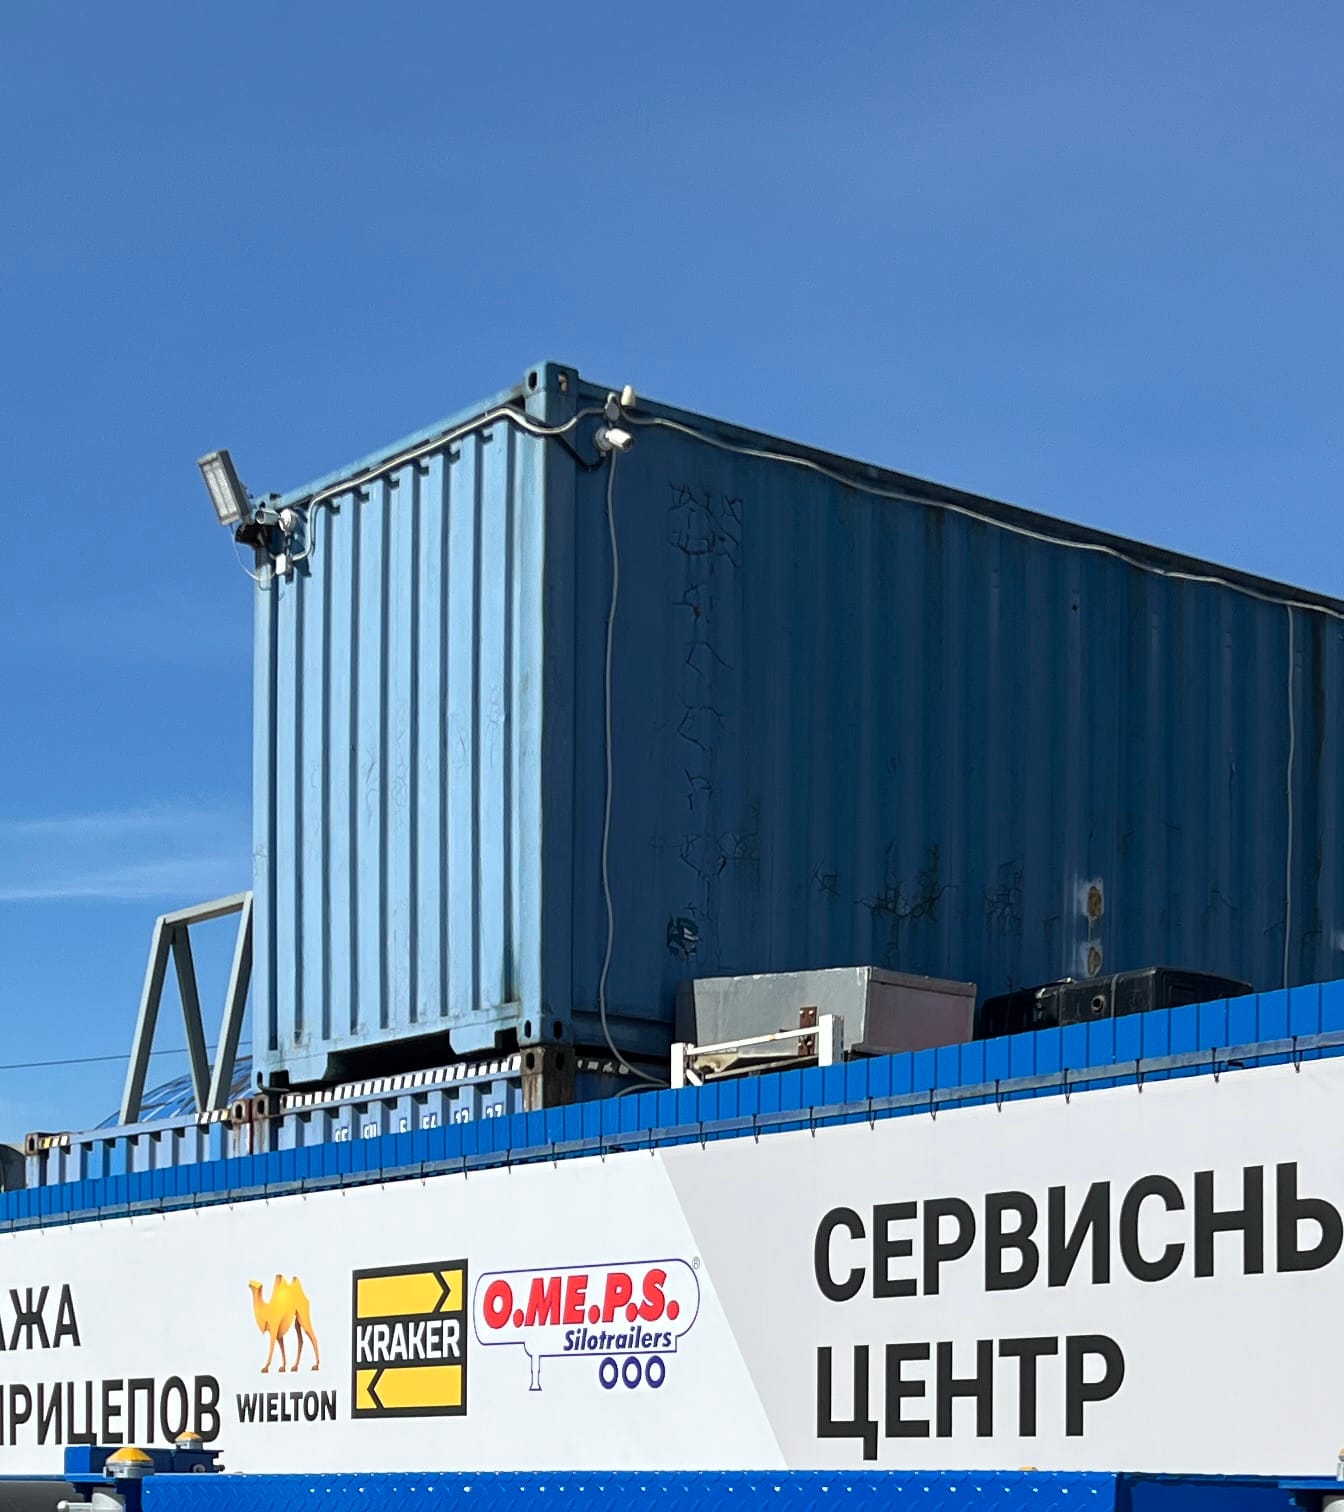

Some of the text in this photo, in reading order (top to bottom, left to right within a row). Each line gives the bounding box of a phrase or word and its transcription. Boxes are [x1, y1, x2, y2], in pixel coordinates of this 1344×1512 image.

[355, 1319, 461, 1363] KRAKER
[563, 1326, 673, 1351] Silotrailers
[235, 1390, 337, 1424] WIELTON
[814, 1333, 1126, 1461] ЦЕНТР
